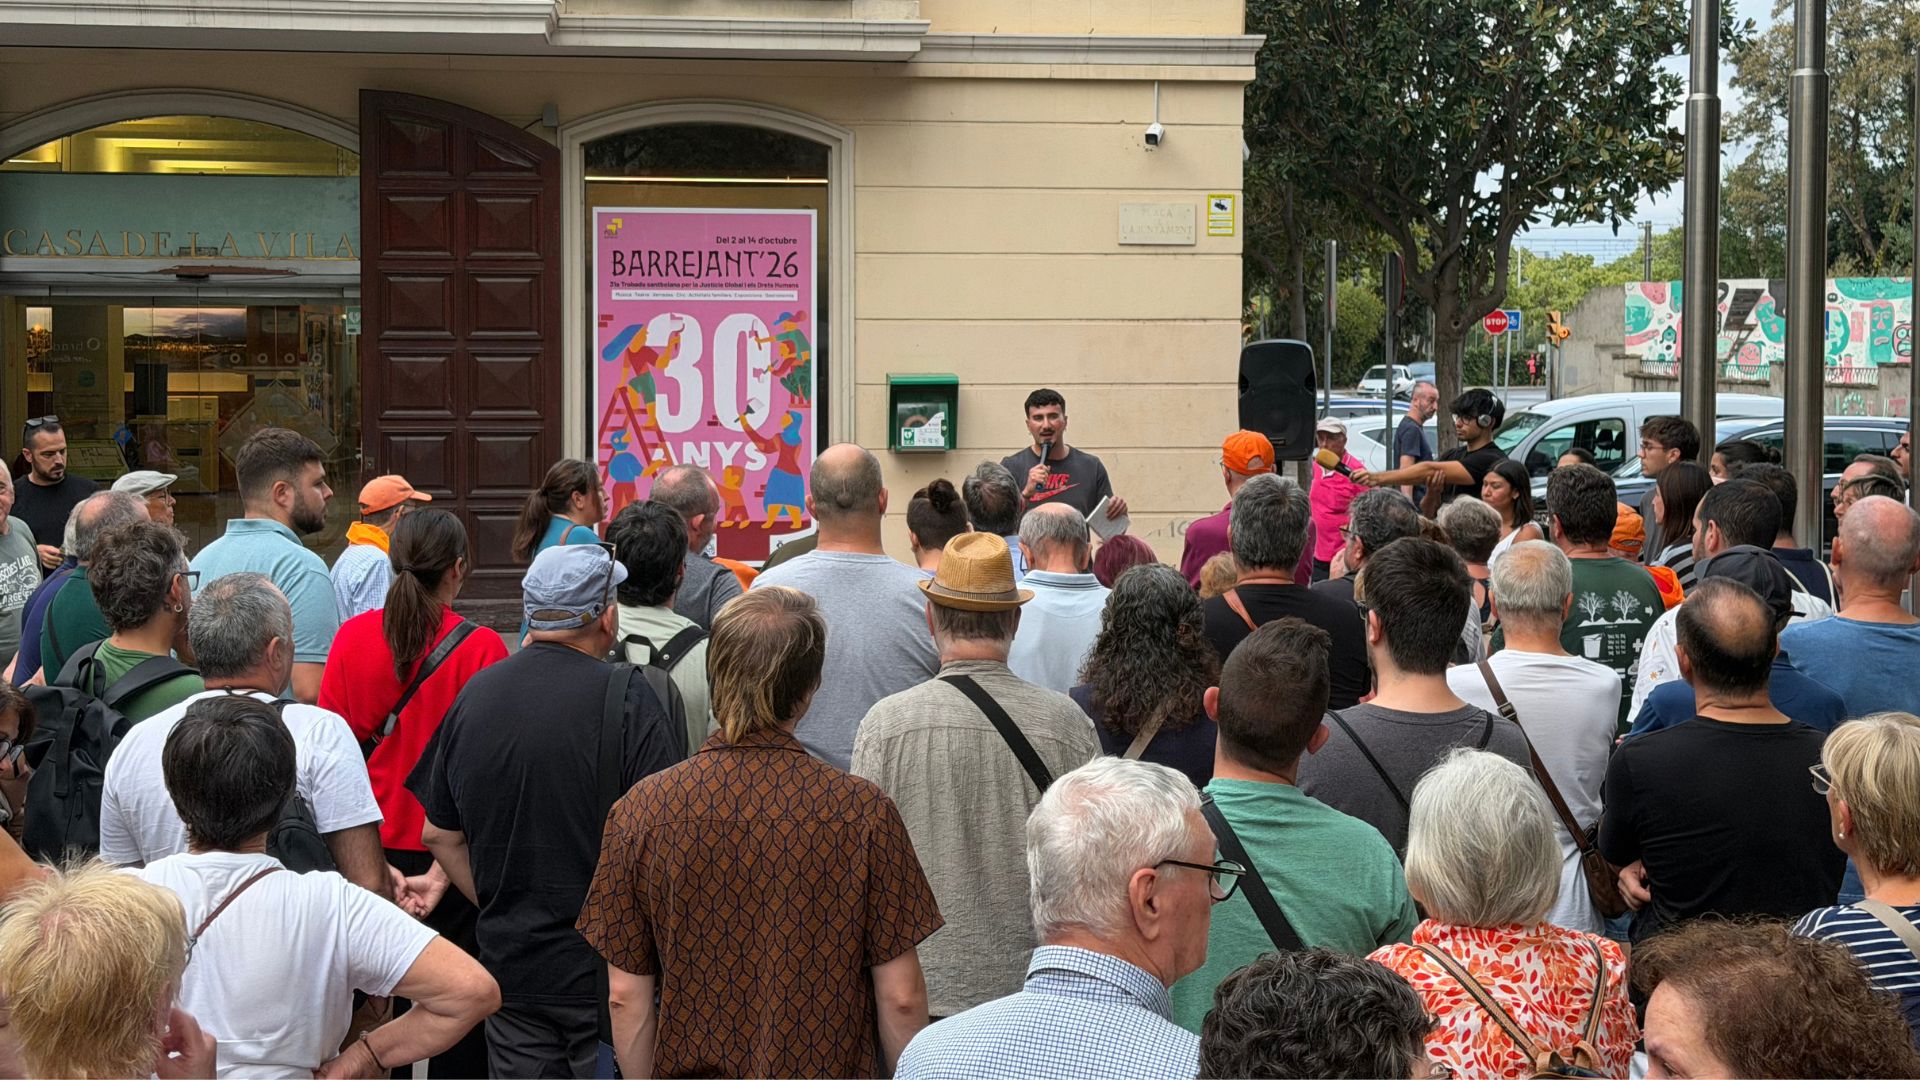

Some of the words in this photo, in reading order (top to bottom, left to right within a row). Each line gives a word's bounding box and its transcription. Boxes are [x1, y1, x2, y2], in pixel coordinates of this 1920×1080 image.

[4, 229, 111, 257] CASA
[120, 231, 175, 257] DE
[188, 232, 240, 258] LA
[255, 232, 359, 259] VILA
[716, 236, 729, 244] Del
[731, 236, 736, 244] 2
[738, 236, 746, 244] al
[748, 236, 756, 244] 14
[758, 236, 798, 244] d'octubre
[612, 250, 798, 279] BARREJANT'26
[1486, 318, 1507, 326] STOP
[645, 312, 772, 433] 30
[652, 441, 767, 471] ANYS
[1045, 473, 1070, 489] IKE
